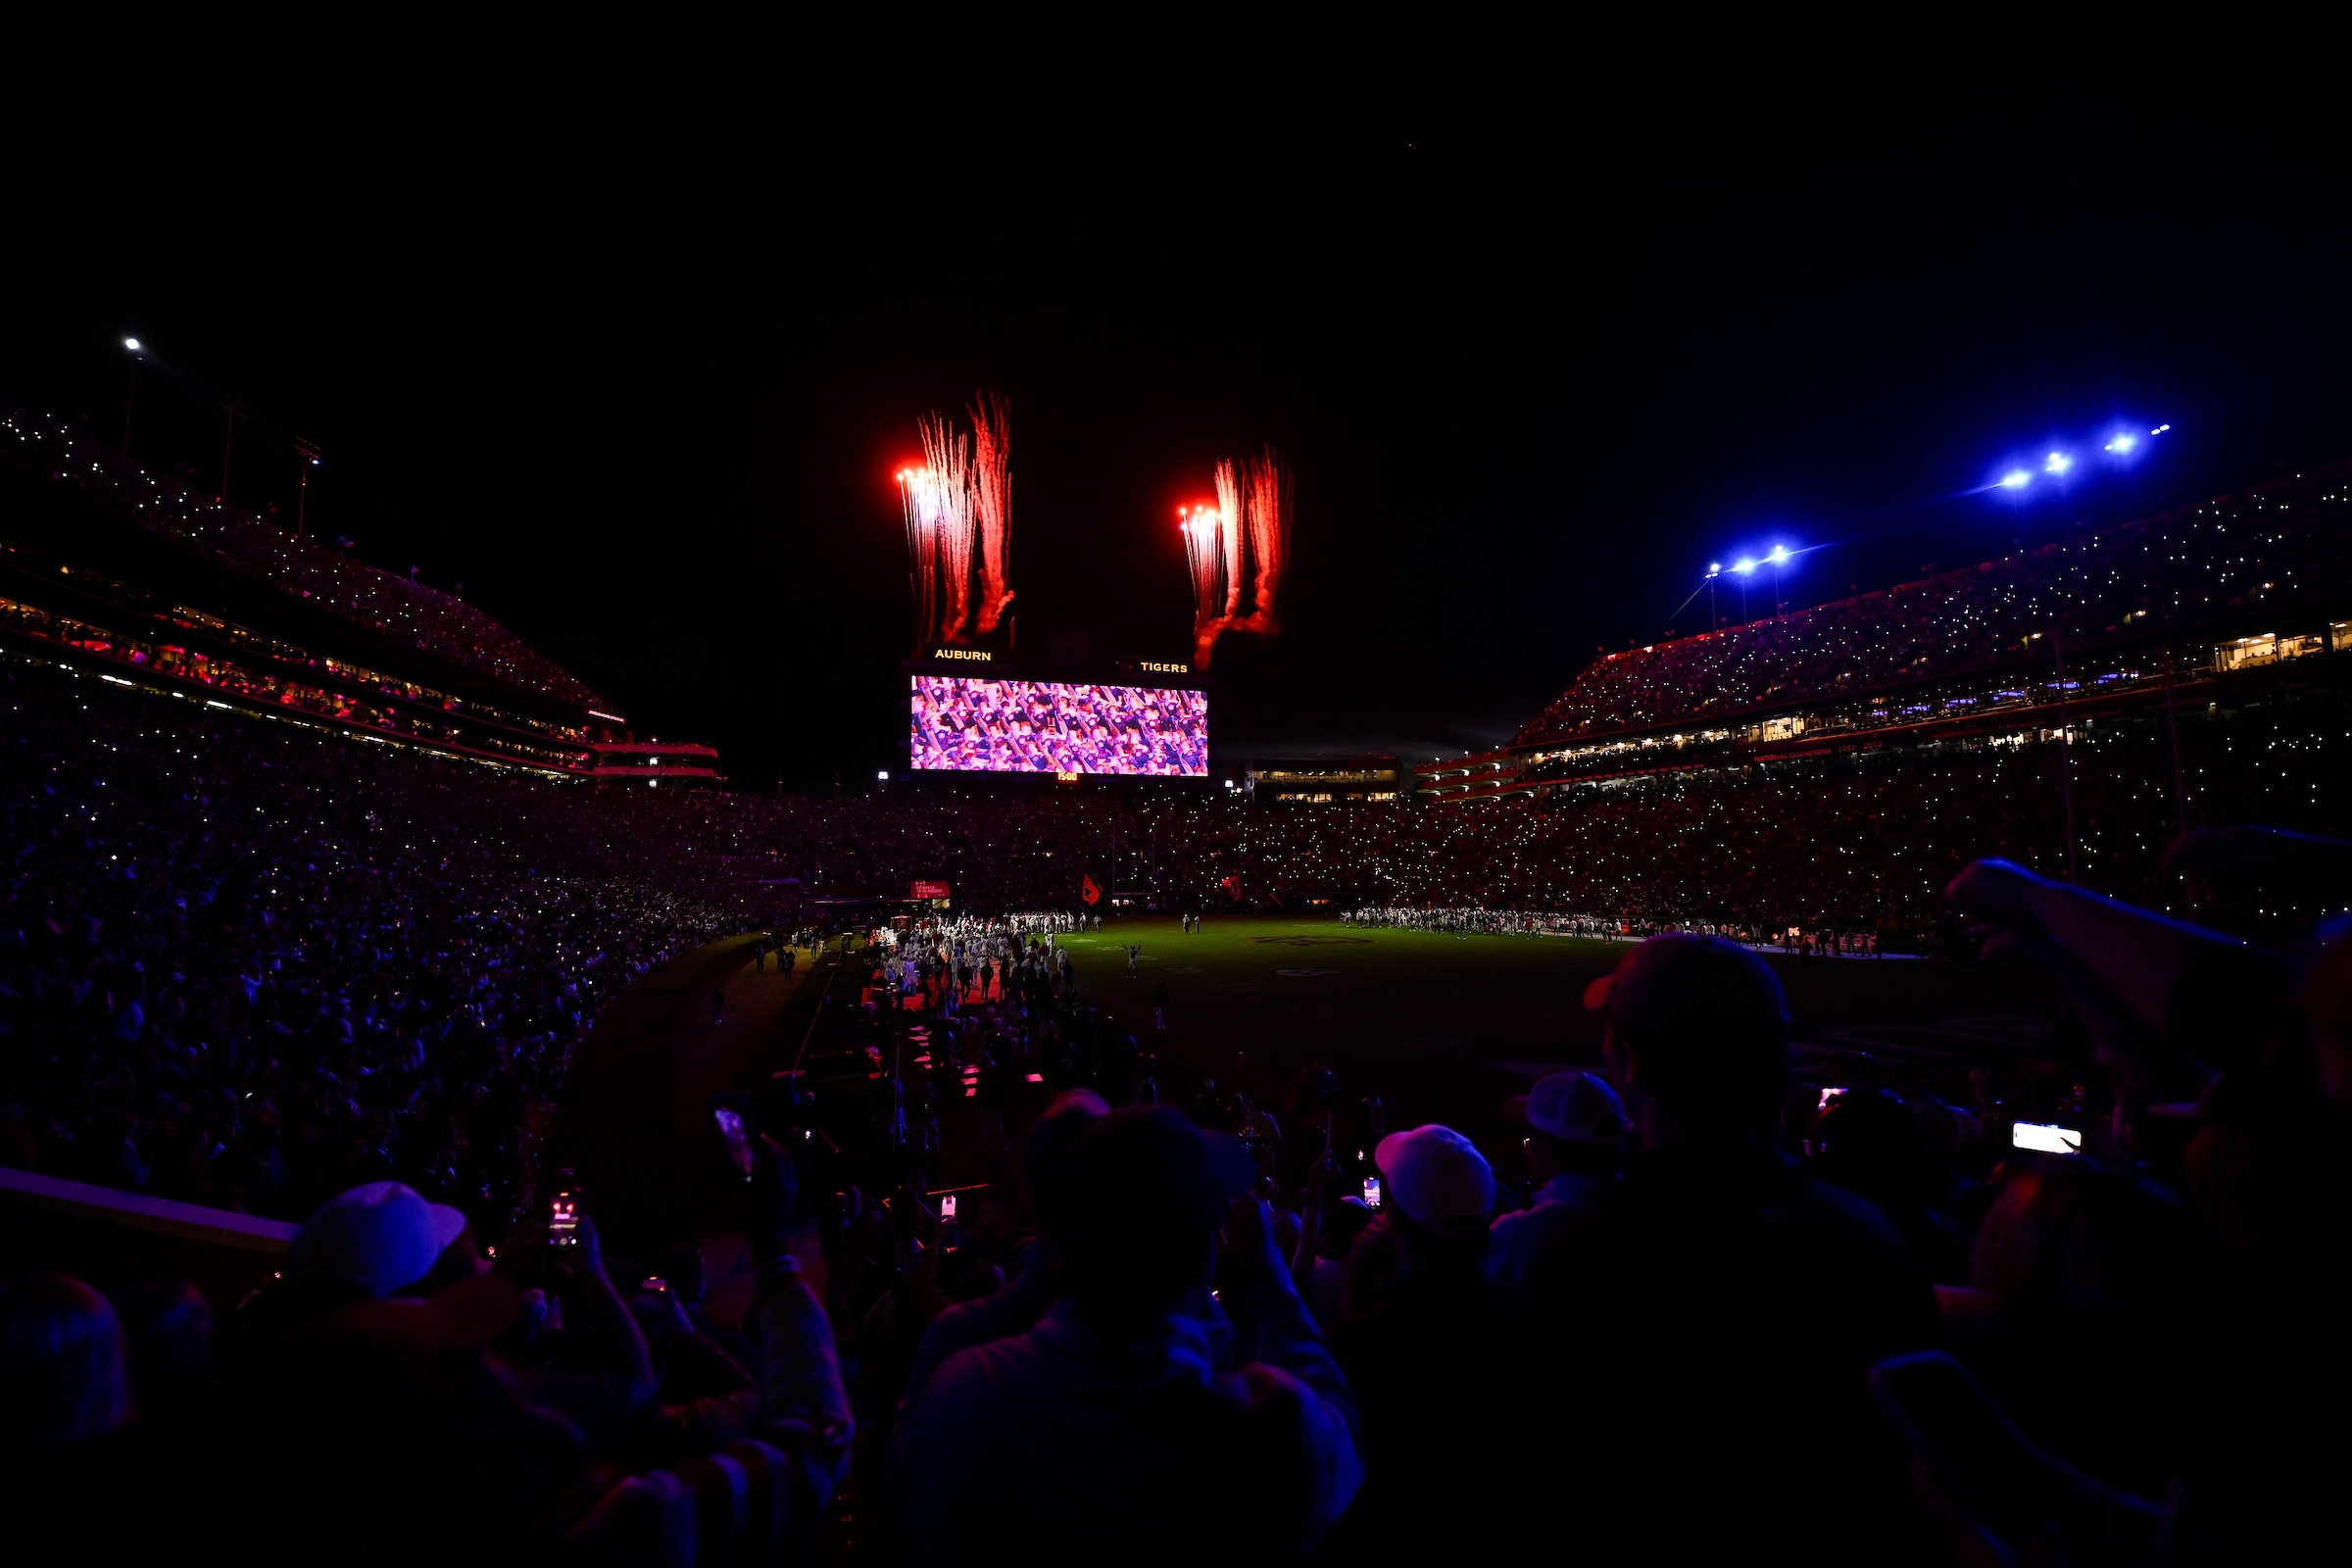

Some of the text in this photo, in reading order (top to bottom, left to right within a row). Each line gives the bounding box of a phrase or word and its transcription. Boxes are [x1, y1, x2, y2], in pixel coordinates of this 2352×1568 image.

[934, 649, 992, 662] AUBURN
[1140, 662, 1188, 673] TIGERS
[1753, 753, 1788, 762] NATIONAL
[1789, 748, 1832, 759] CHAMPIONS
[1863, 741, 1883, 750] 2010
